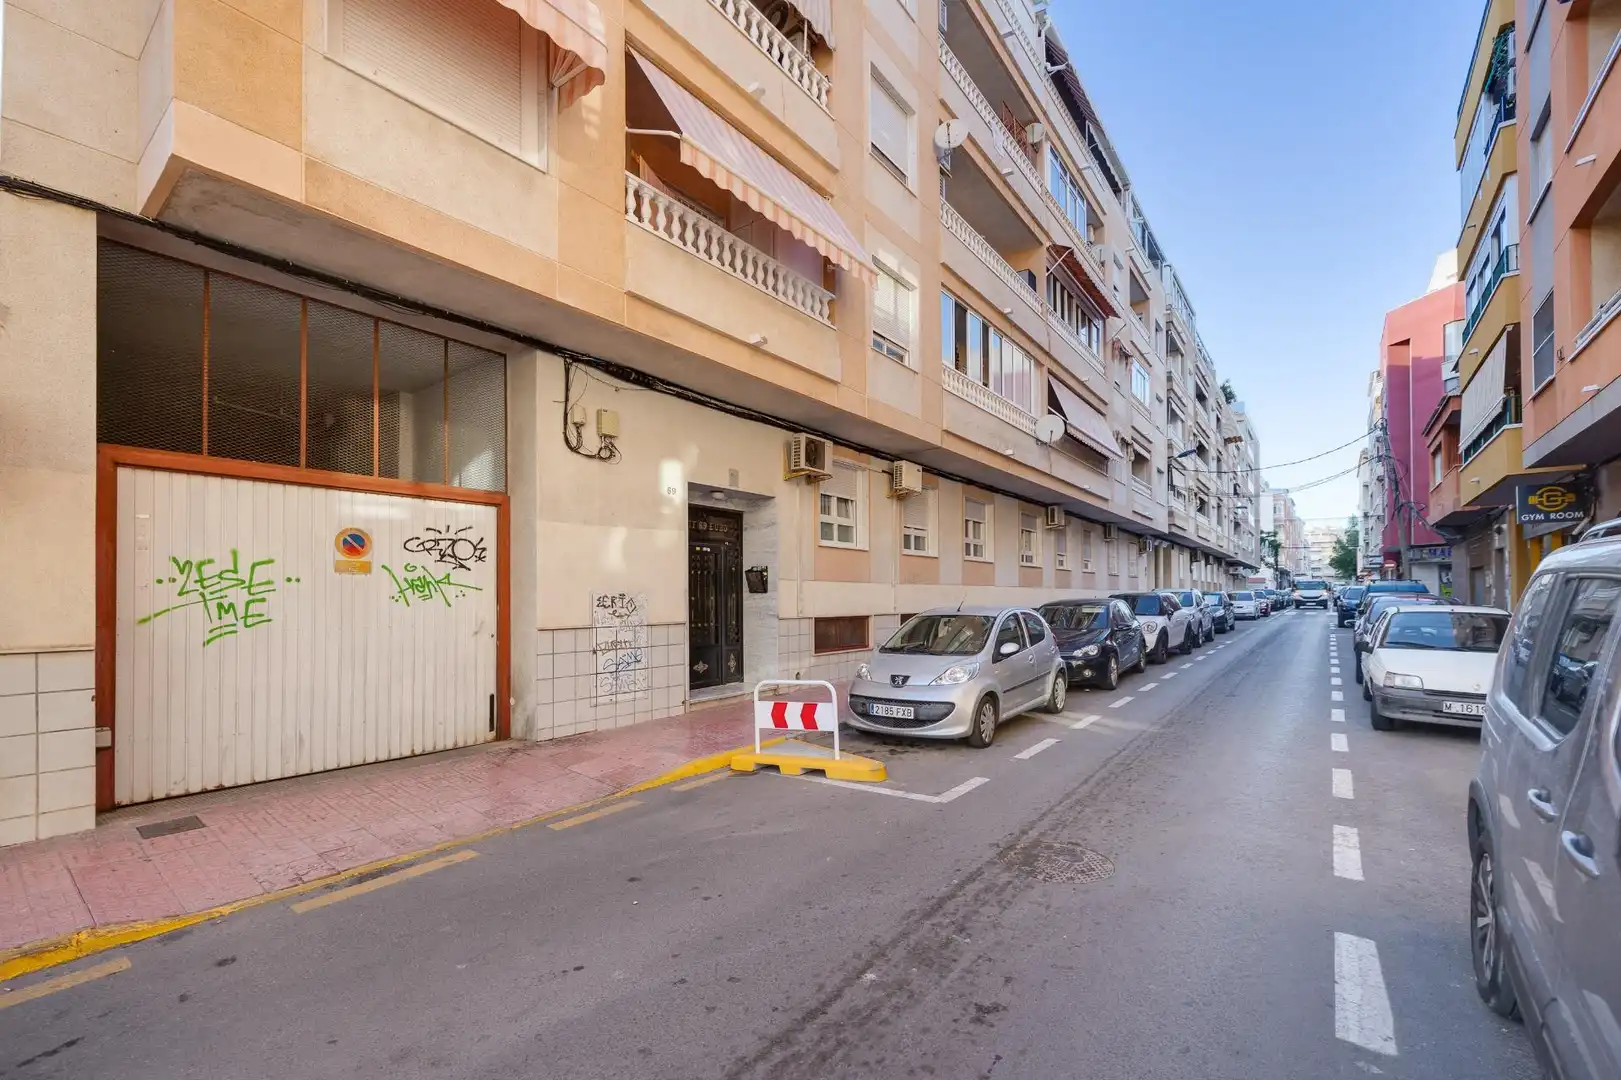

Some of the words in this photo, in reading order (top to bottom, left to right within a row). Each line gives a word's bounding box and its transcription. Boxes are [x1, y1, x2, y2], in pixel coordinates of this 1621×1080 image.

[666, 486, 677, 495] 69
[1521, 513, 1545, 521] GYM
[1549, 511, 1585, 520] ROOM
[874, 705, 894, 716] 2185
[896, 707, 913, 718] FXB
